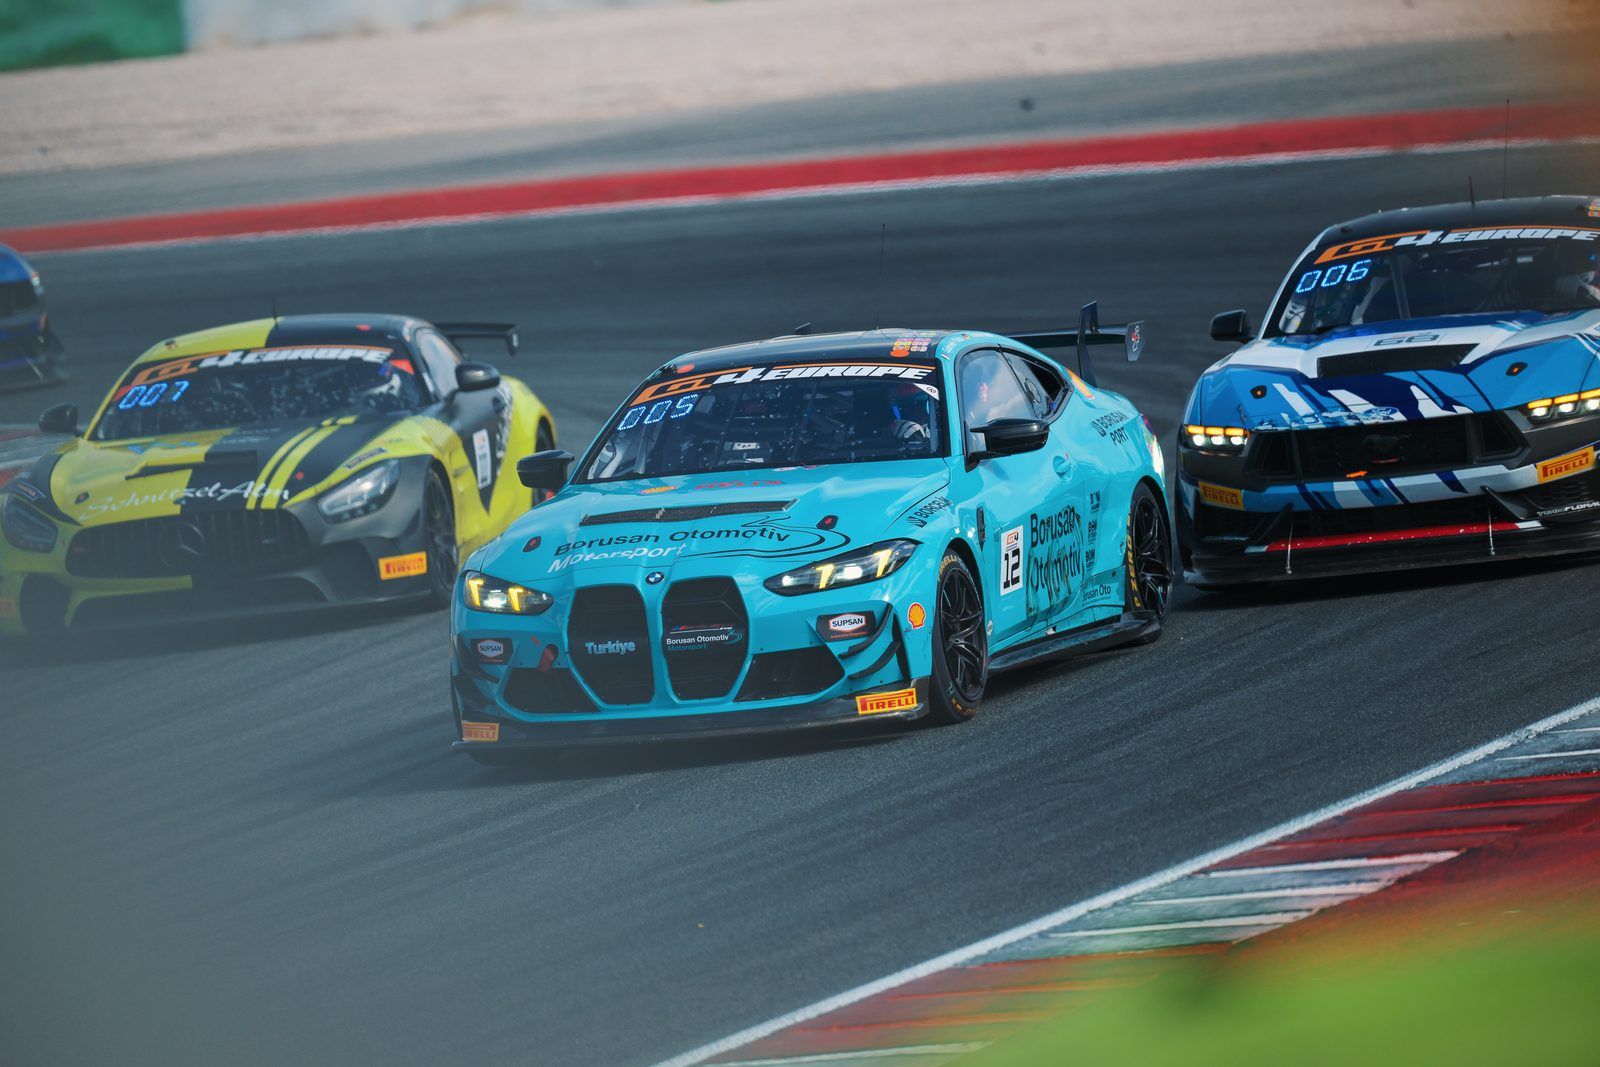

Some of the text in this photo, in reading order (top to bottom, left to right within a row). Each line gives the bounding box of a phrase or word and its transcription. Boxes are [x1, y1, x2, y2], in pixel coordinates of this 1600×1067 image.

[1440, 228, 1600, 243] EUROPE
[1295, 259, 1372, 294] 006
[241, 346, 394, 365] EUROPE
[766, 365, 936, 381] EUROPE
[118, 380, 190, 410] 007
[616, 394, 700, 432] 005
[1541, 452, 1589, 478] PIRELLI
[1202, 485, 1239, 505] PIRELLI
[1029, 504, 1076, 549] Borusan
[554, 527, 790, 557] Borusan Otomotiv
[547, 542, 689, 574] Motorsport
[1002, 547, 1021, 590] 12
[1098, 584, 1112, 596] Oto
[831, 617, 864, 628] SUPSAN
[478, 643, 504, 652] SUPSAN
[666, 634, 730, 646] Borusan Otomotiv
[859, 690, 915, 711] PIRELLI
